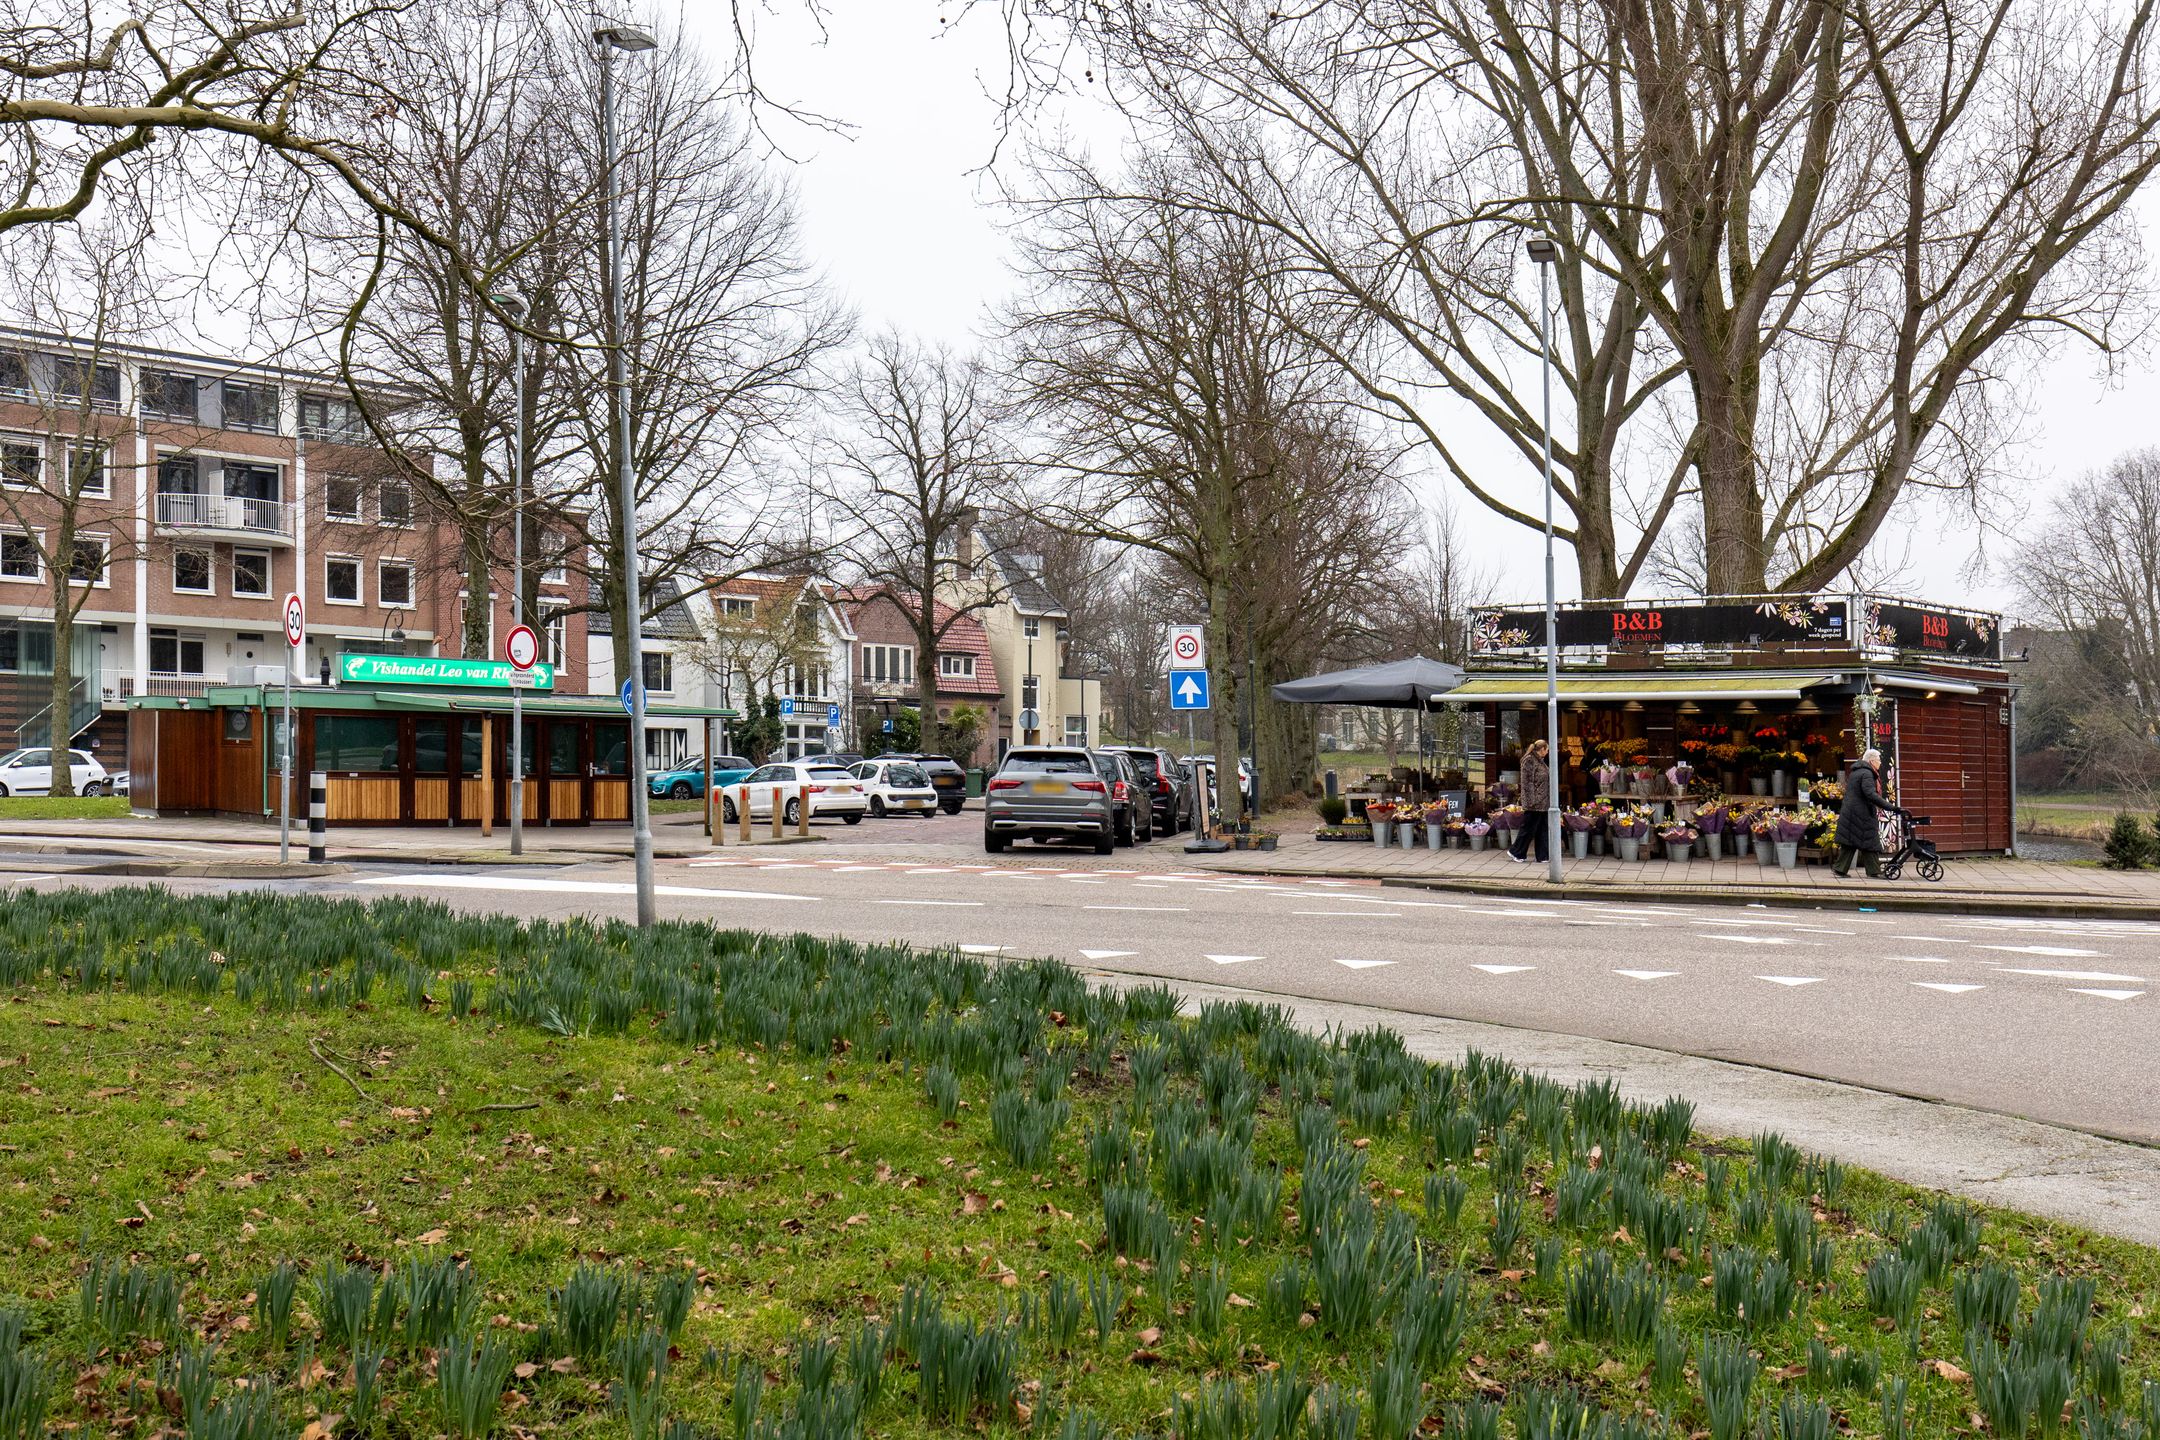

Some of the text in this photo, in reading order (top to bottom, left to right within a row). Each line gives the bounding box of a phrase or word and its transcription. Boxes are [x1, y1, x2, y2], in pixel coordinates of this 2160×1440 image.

[290, 611, 300, 630] 30
[1612, 612, 1662, 630] B&B
[1922, 615, 1949, 636] B&B
[1179, 642, 1195, 652] 30
[371, 661, 436, 677] Vishandel
[438, 665, 462, 677] Leo
[465, 669, 488, 679] van
[784, 700, 791, 712] P
[830, 707, 837, 718] P
[883, 720, 889, 728] P
